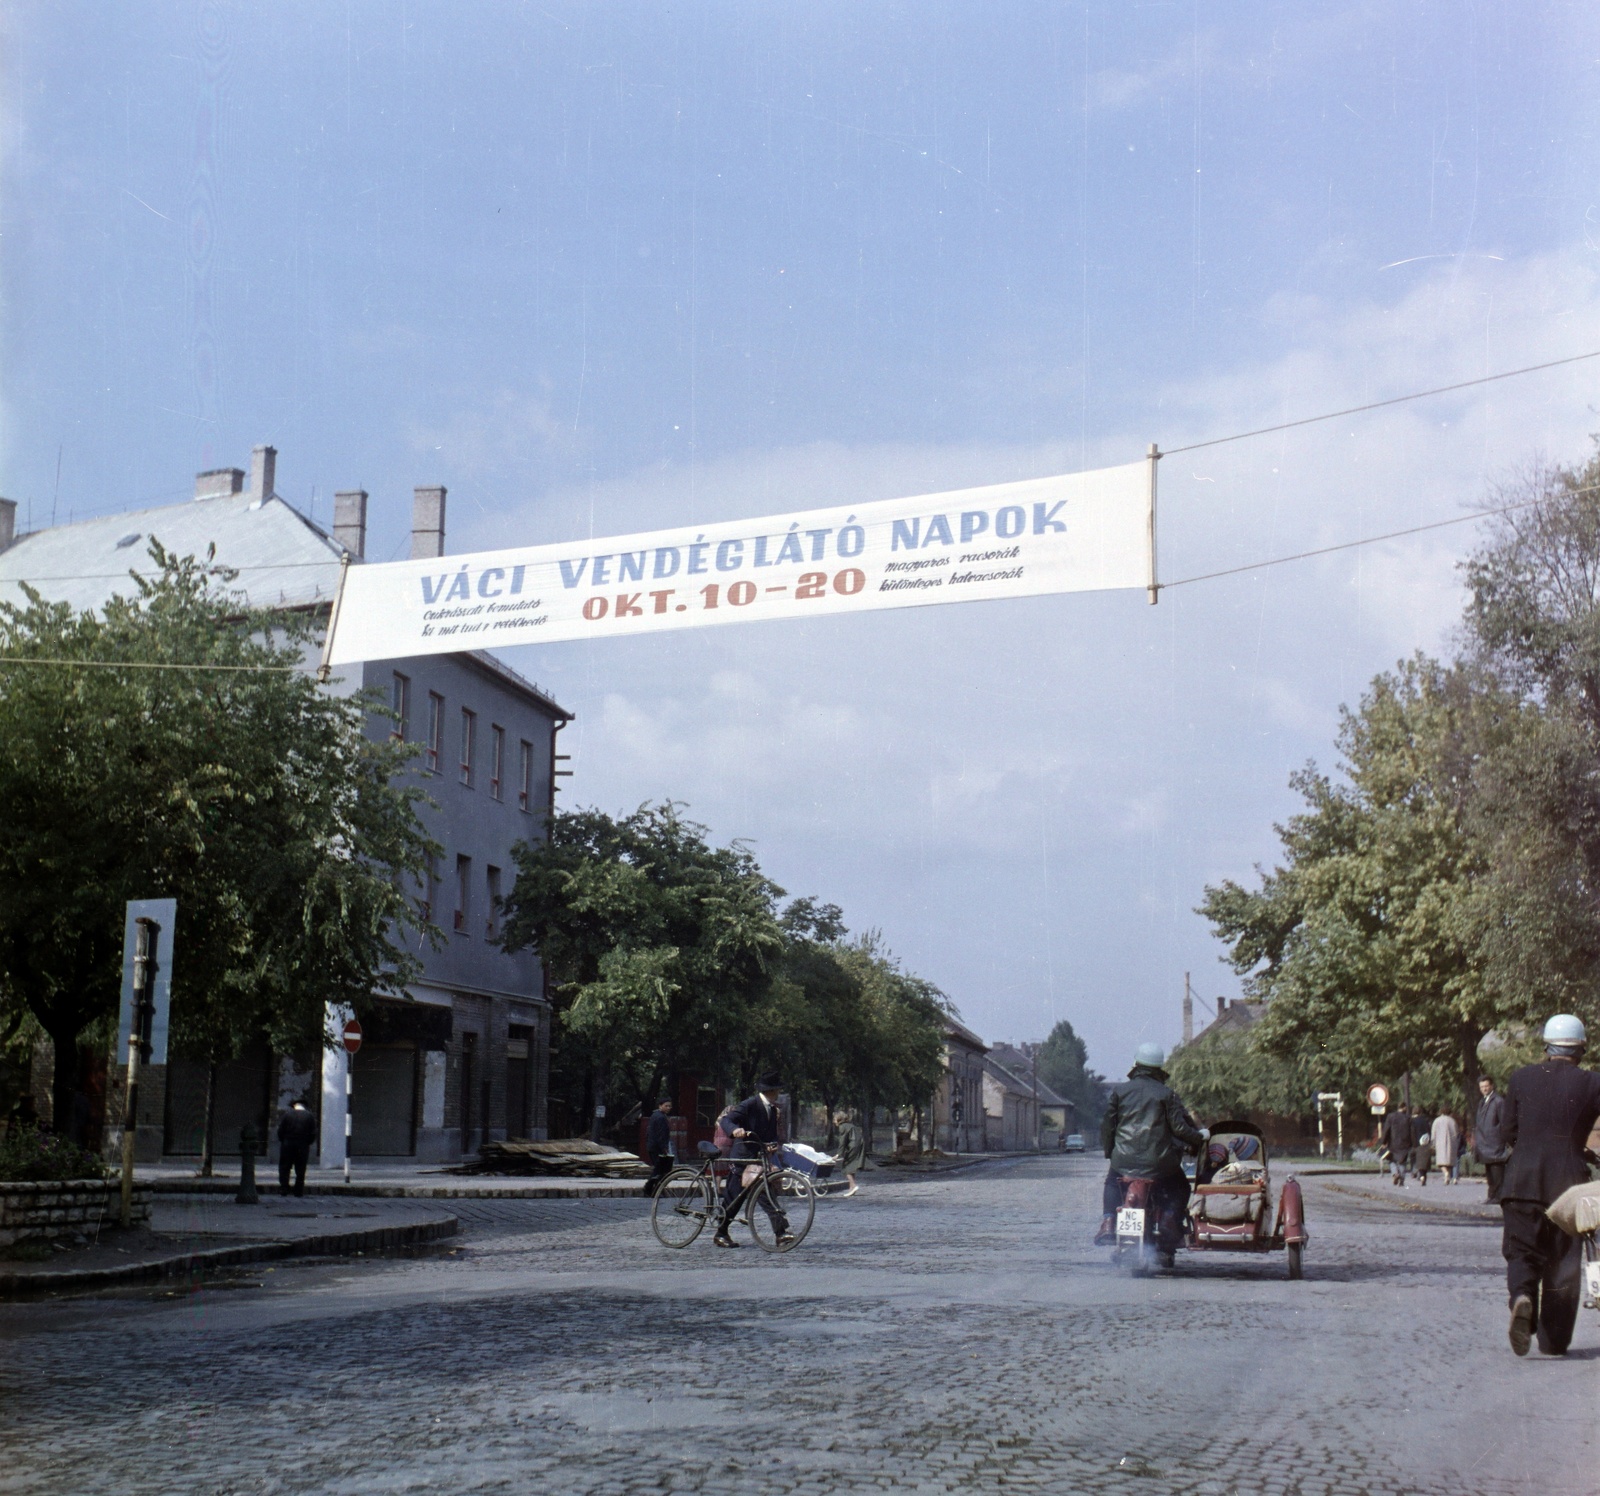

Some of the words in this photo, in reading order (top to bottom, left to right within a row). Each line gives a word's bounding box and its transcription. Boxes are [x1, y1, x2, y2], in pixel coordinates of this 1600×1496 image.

[420, 564, 526, 605] VÁCI
[557, 515, 867, 590] VENDÉGLÁTÓ
[891, 501, 1067, 553] NAPOK
[885, 557, 950, 572] magyaros
[959, 545, 1020, 563] vacsorák
[878, 577, 943, 592] különleges
[583, 588, 689, 621] OKT.
[1125, 1211, 1137, 1221] NC
